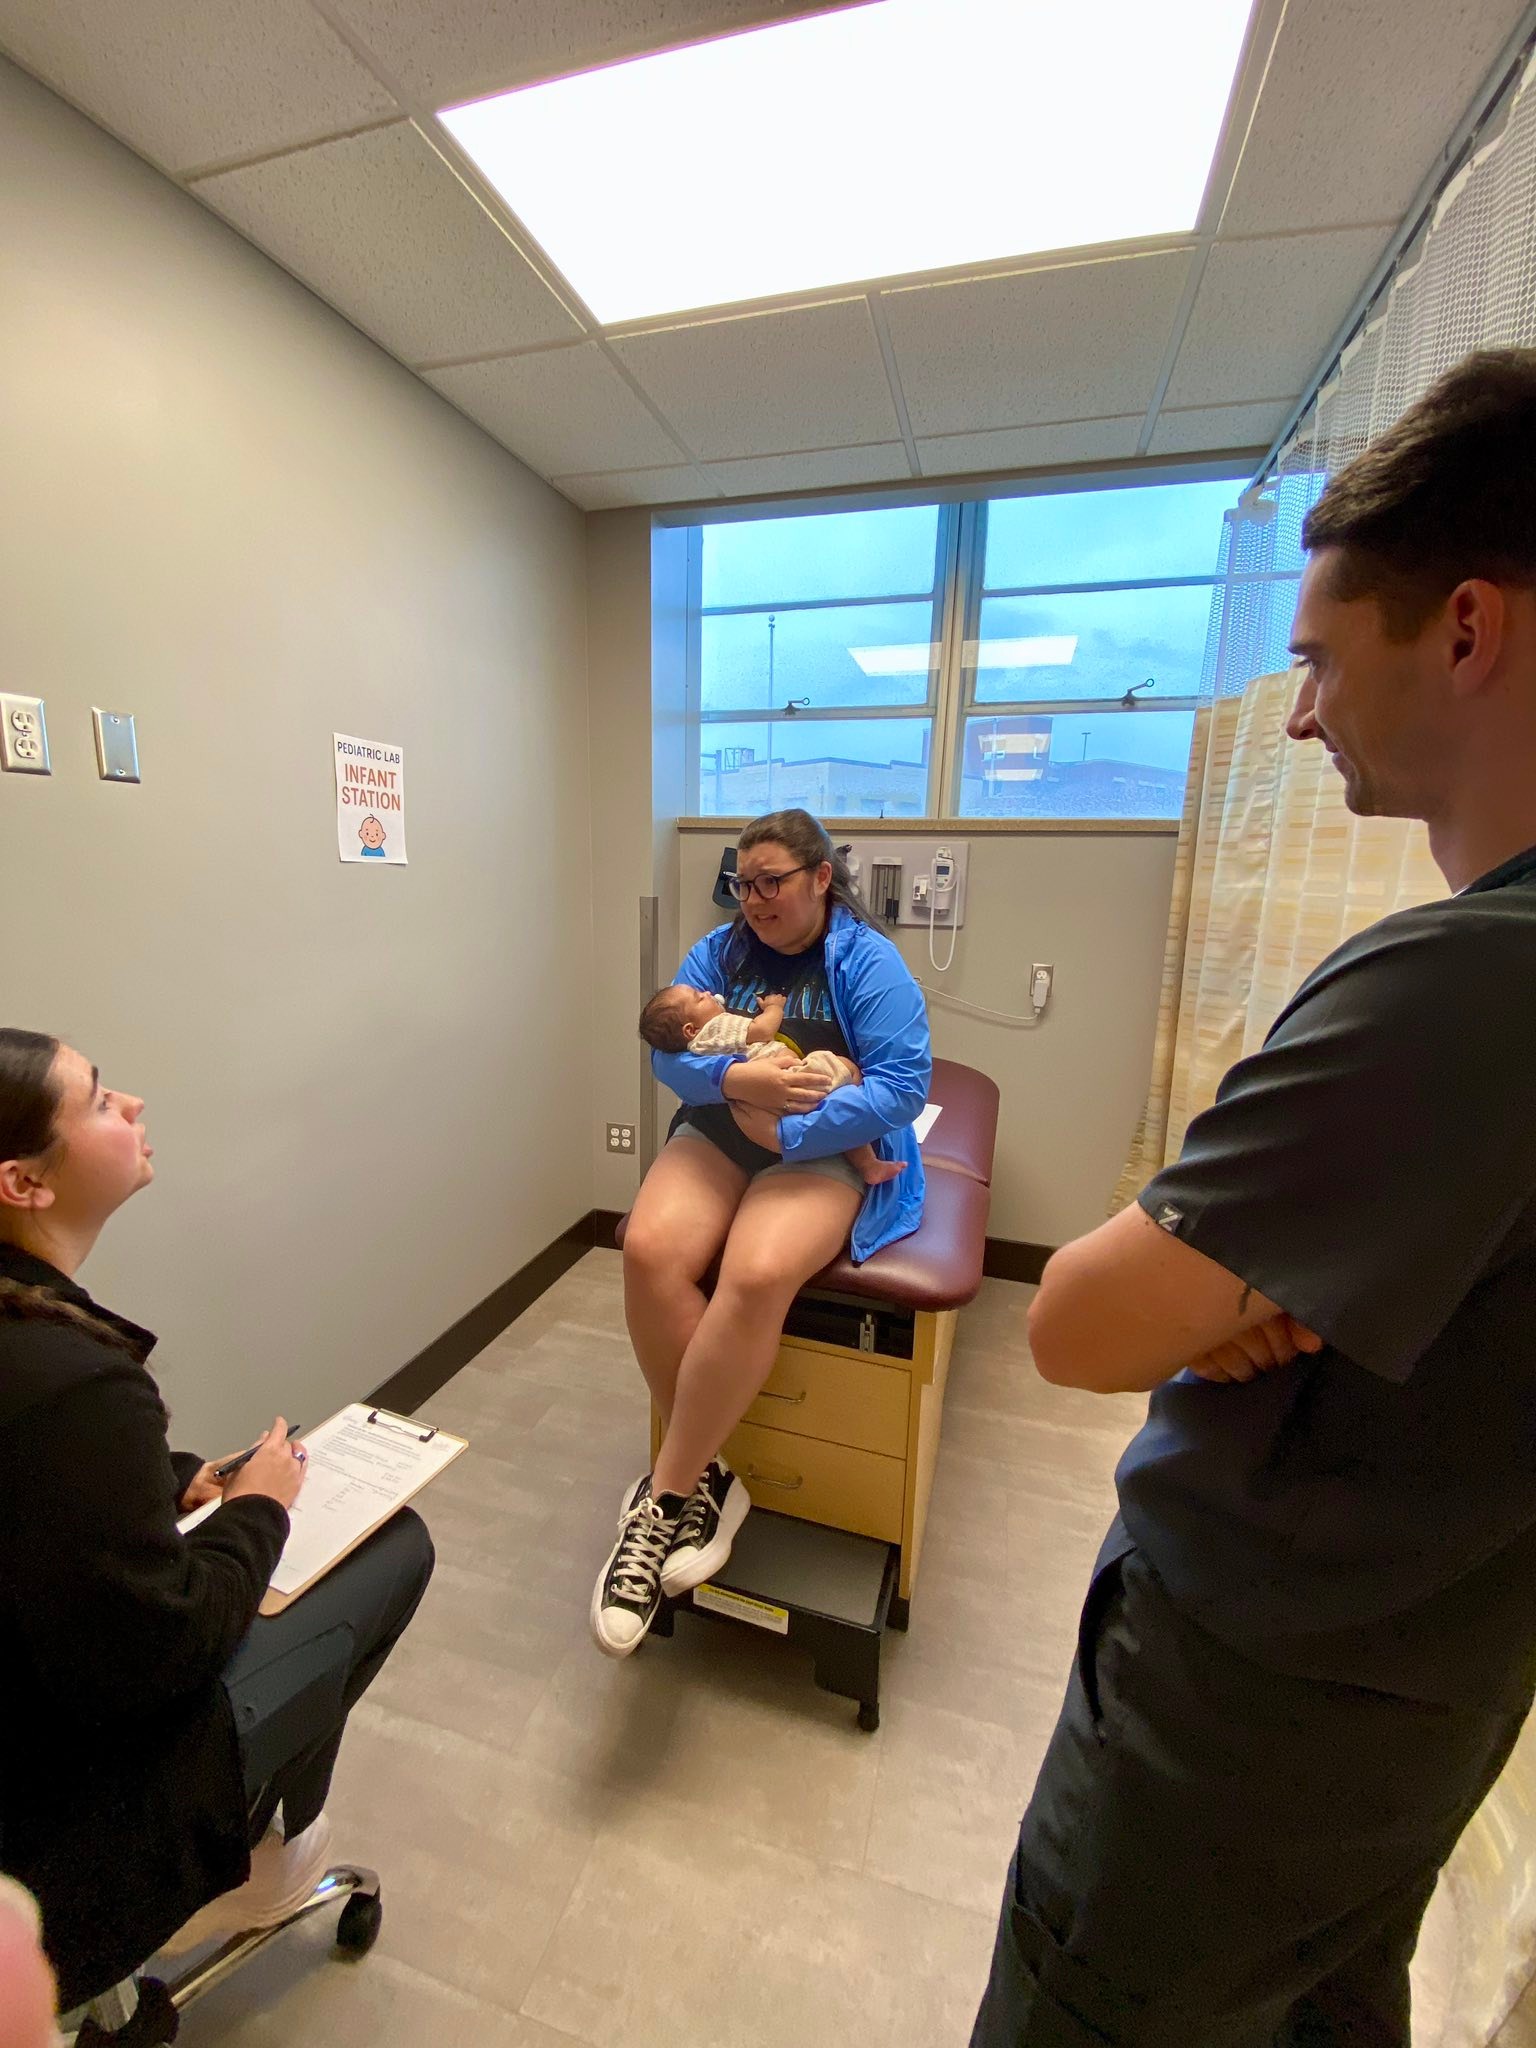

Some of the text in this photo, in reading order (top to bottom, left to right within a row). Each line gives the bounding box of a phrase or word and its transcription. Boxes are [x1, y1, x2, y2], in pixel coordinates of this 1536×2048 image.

[337, 741, 400, 764] PEDIATRIC LAB
[344, 763, 397, 789] INFANT
[341, 786, 400, 811] STATION
